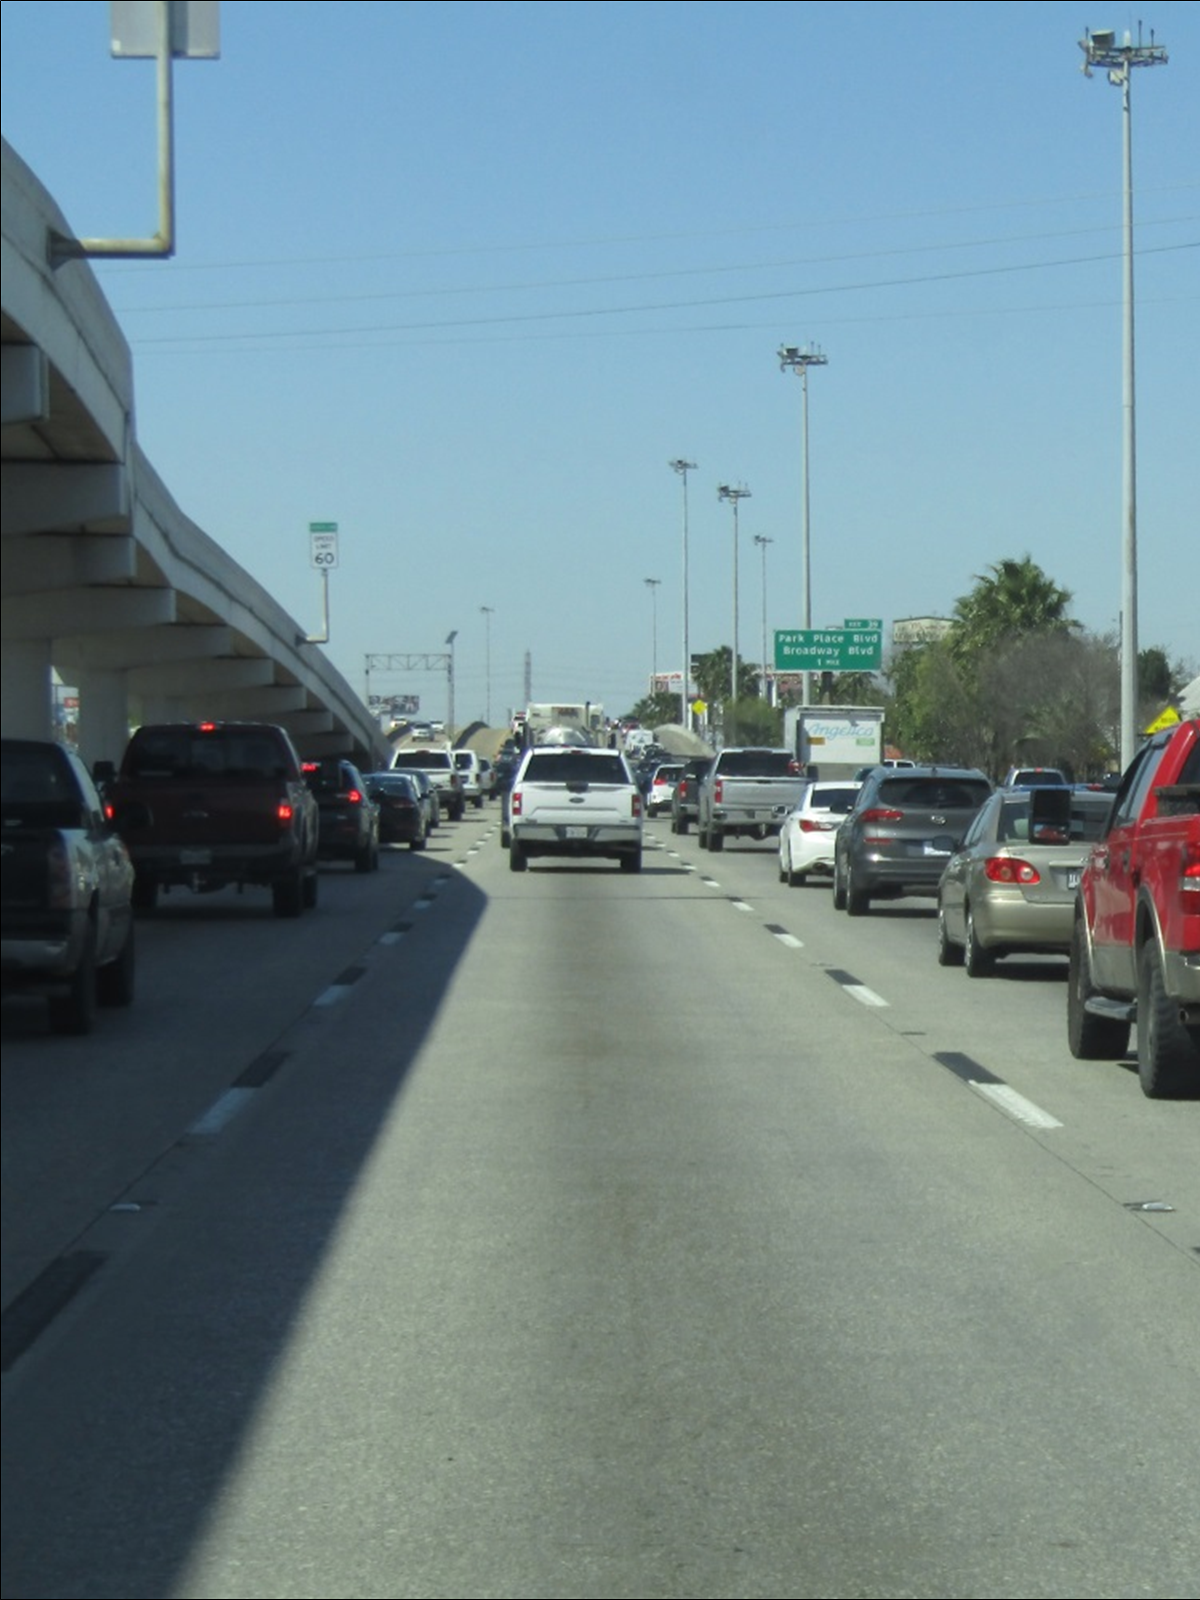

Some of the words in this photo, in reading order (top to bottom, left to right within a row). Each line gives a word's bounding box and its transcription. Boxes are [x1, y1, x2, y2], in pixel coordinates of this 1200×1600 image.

[314, 552, 335, 564] 60
[779, 634, 805, 643] Park
[813, 634, 844, 643] Place
[853, 634, 878, 643] Blvd
[783, 646, 840, 657] Broadway
[848, 646, 874, 655] Blvd
